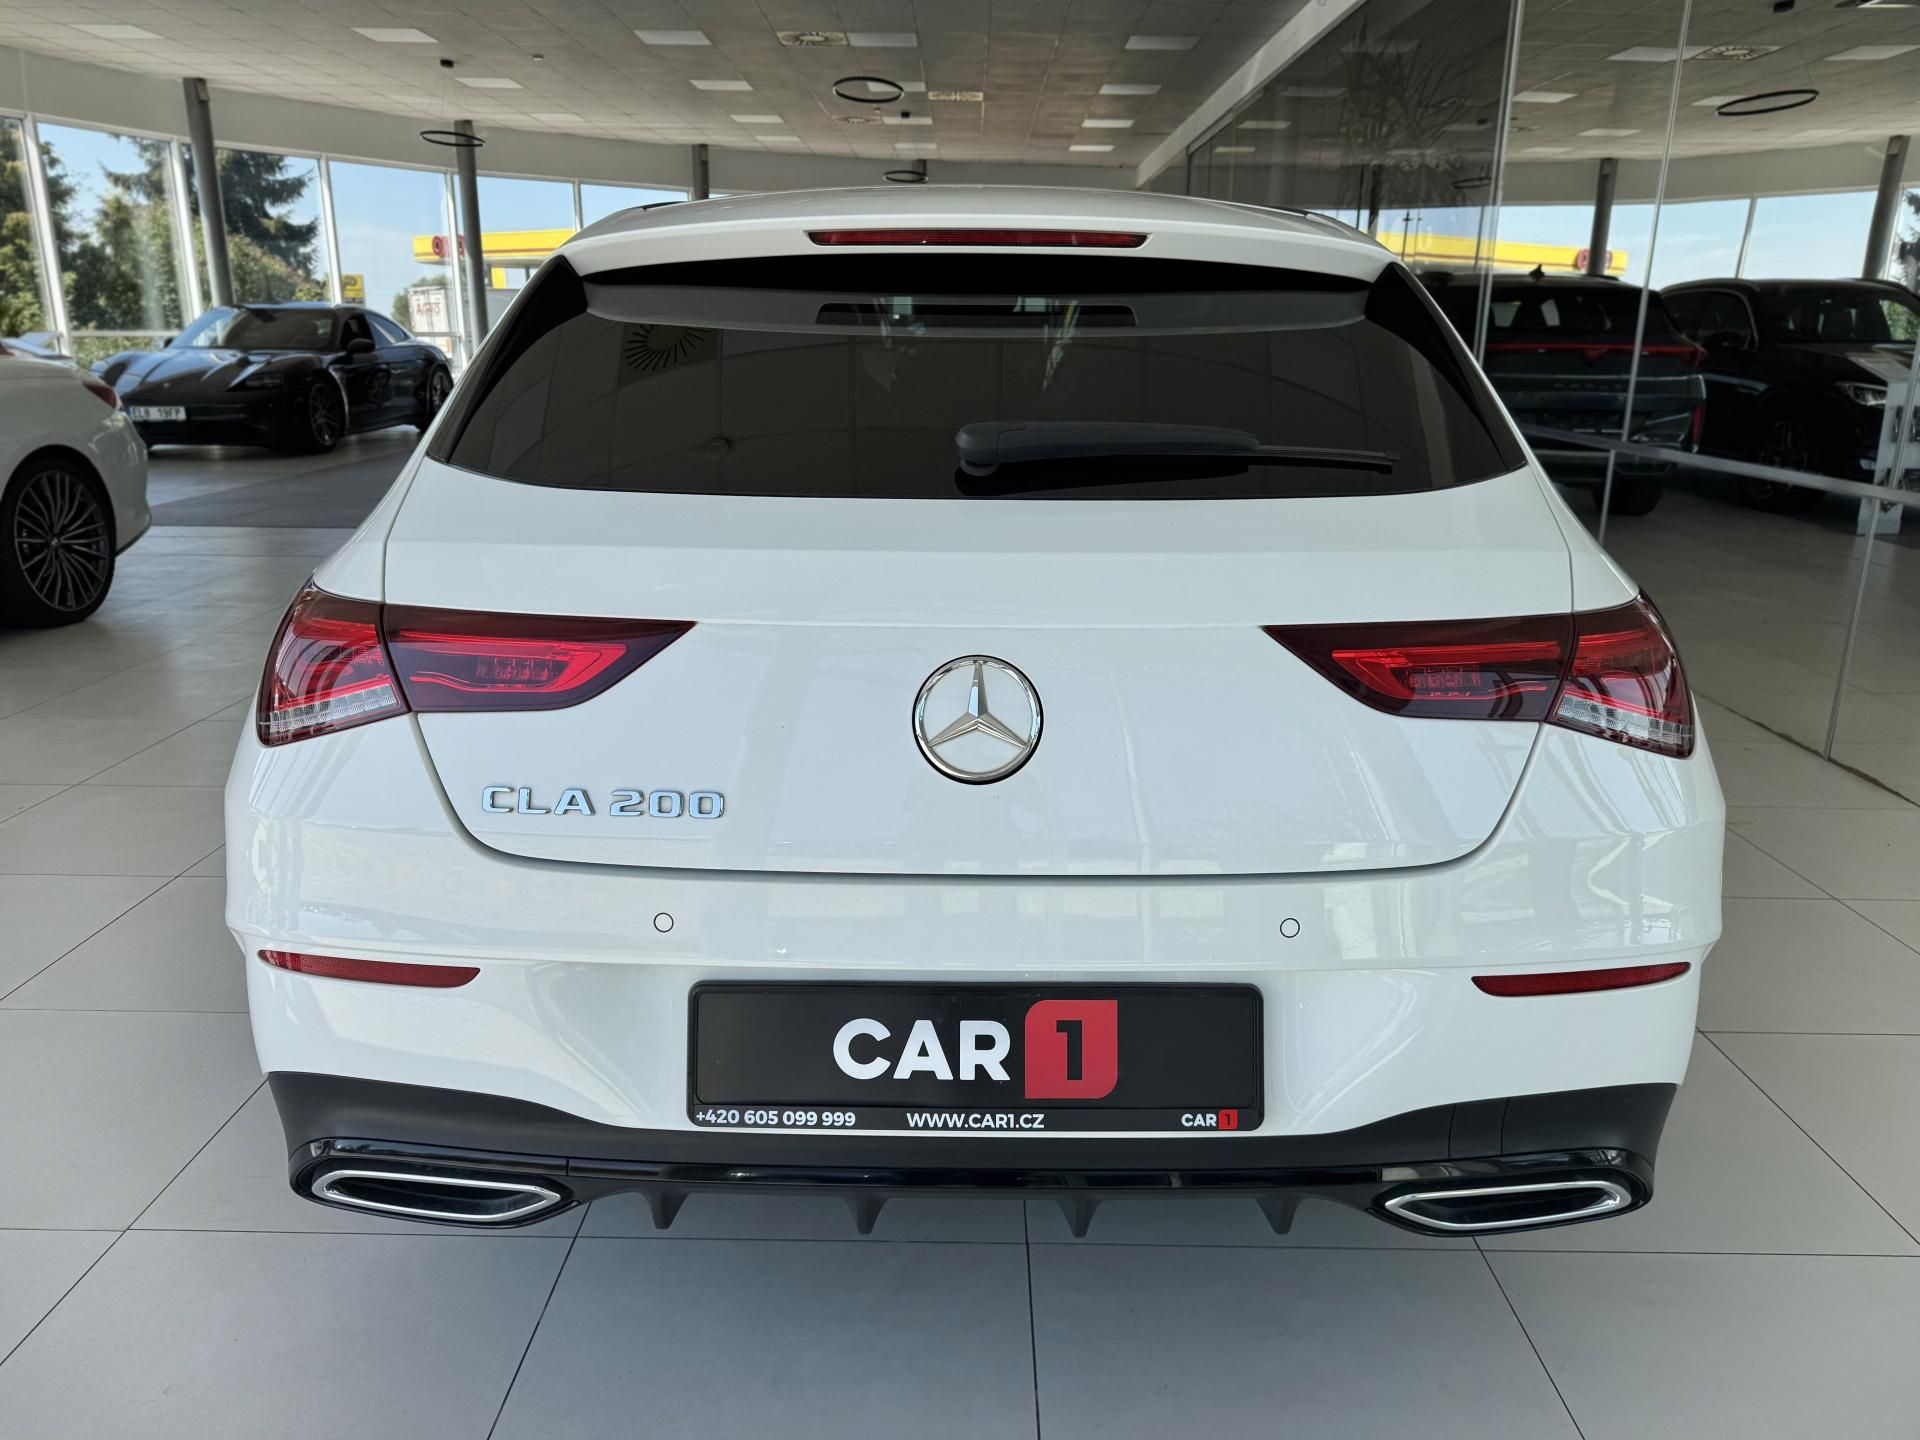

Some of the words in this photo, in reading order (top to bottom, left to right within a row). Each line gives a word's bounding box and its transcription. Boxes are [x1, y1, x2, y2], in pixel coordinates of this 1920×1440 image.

[482, 786, 596, 816] CLA
[609, 789, 725, 818] 200
[696, 1109, 740, 1125] +420
[744, 1110, 779, 1125] 605
[782, 1111, 818, 1126] 099
[821, 1111, 856, 1127] 999
[906, 1112, 1045, 1129] WWW.CAR1.CZ
